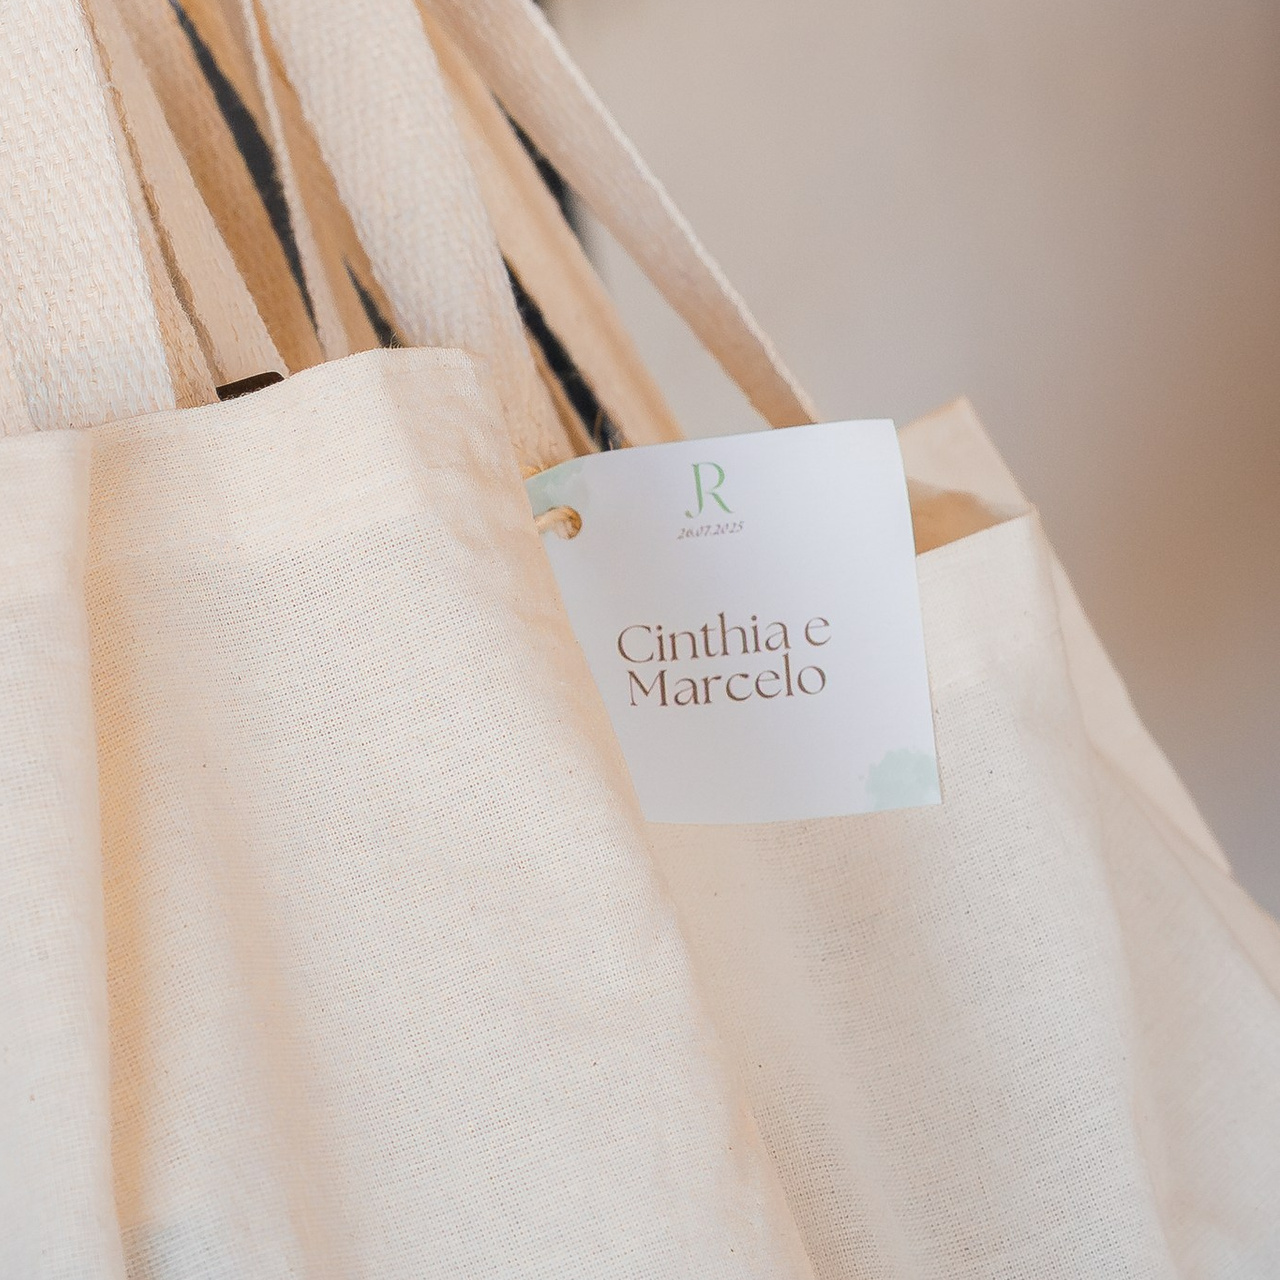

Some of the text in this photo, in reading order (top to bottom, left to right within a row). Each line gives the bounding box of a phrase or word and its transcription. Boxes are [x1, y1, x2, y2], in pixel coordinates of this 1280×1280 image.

[685, 461, 734, 518] JR
[617, 612, 832, 664] Cinthia e
[627, 654, 827, 707] Marcelo
